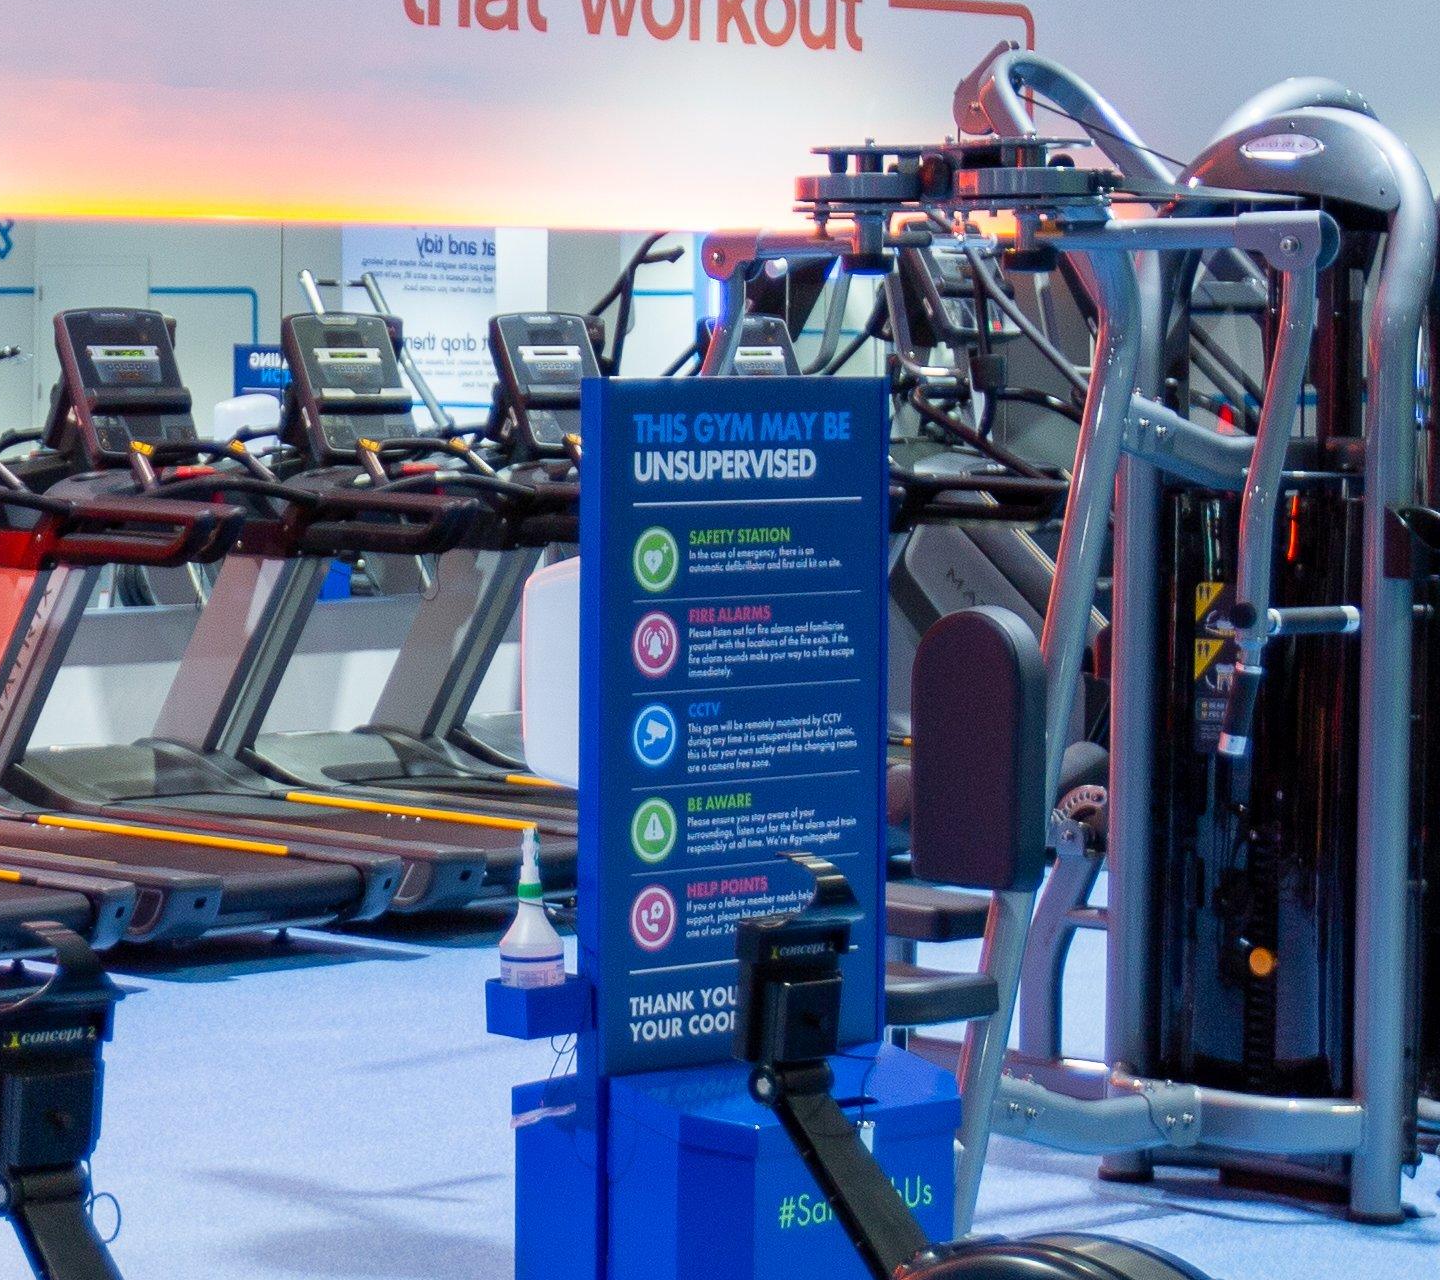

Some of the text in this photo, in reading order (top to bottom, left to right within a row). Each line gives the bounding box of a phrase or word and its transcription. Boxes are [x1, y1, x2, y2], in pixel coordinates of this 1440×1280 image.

[633, 412, 851, 443] THIS GYM MAY BE
[634, 448, 817, 481] UNSUPERVISED
[689, 527, 790, 545] SAFETY STATION
[689, 546, 814, 560] In the case of emergency, there is an
[689, 562, 723, 573] automatic
[725, 561, 765, 571] defibrillator
[767, 559, 780, 569] and
[782, 559, 794, 568] first
[796, 559, 807, 568] aid
[809, 558, 817, 567] kit
[688, 606, 770, 623] FIRE ALARMS
[689, 627, 711, 638] Please
[713, 625, 731, 636] listen
[733, 626, 745, 635] out
[746, 625, 756, 635] for
[758, 624, 769, 634] fire
[771, 623, 793, 633] alarms
[795, 622, 808, 632] and
[689, 633, 848, 652] yourself with the locations of the fire the
[688, 653, 700, 664] fire
[702, 653, 722, 663] alarm
[724, 652, 748, 662] sounds
[750, 650, 768, 661] make
[770, 652, 785, 662] your
[788, 651, 802, 661] way
[804, 649, 811, 657] to
[819, 647, 829, 656] fire
[831, 648, 854, 658] escape
[688, 702, 720, 717] CCTV
[688, 713, 841, 735] This gym will be remotely monitored by CCTV
[688, 737, 711, 748] during
[728, 734, 742, 744] time
[744, 733, 748, 742] it
[750, 733, 755, 742] is
[757, 729, 801, 742] unsupervised
[803, 729, 814, 738] but
[688, 740, 857, 759] this is for your own safety and the changing rooms
[688, 764, 700, 773] are
[708, 761, 734, 771] camera
[736, 758, 750, 768] free
[688, 793, 752, 812] BE AWARE
[687, 807, 815, 827] Please ensure you stay aware of your
[737, 824, 754, 836] listen
[756, 825, 767, 834] out
[769, 822, 778, 832] for
[780, 822, 791, 831] the
[793, 820, 804, 830] fire
[805, 818, 825, 829] alarm
[827, 817, 839, 827] and
[841, 817, 856, 826] train
[687, 840, 727, 854] responsibly
[729, 841, 736, 849] at
[737, 839, 746, 849] all
[687, 876, 768, 898] HELP POINTS
[686, 891, 797, 912] If you fellow member needs
[718, 910, 740, 923] please
[742, 908, 751, 918] hit
[686, 928, 722, 938] one our
[629, 990, 695, 1017] THANK
[21, 1025, 96, 1043] concept 2
[629, 1018, 683, 1042] YOUR
